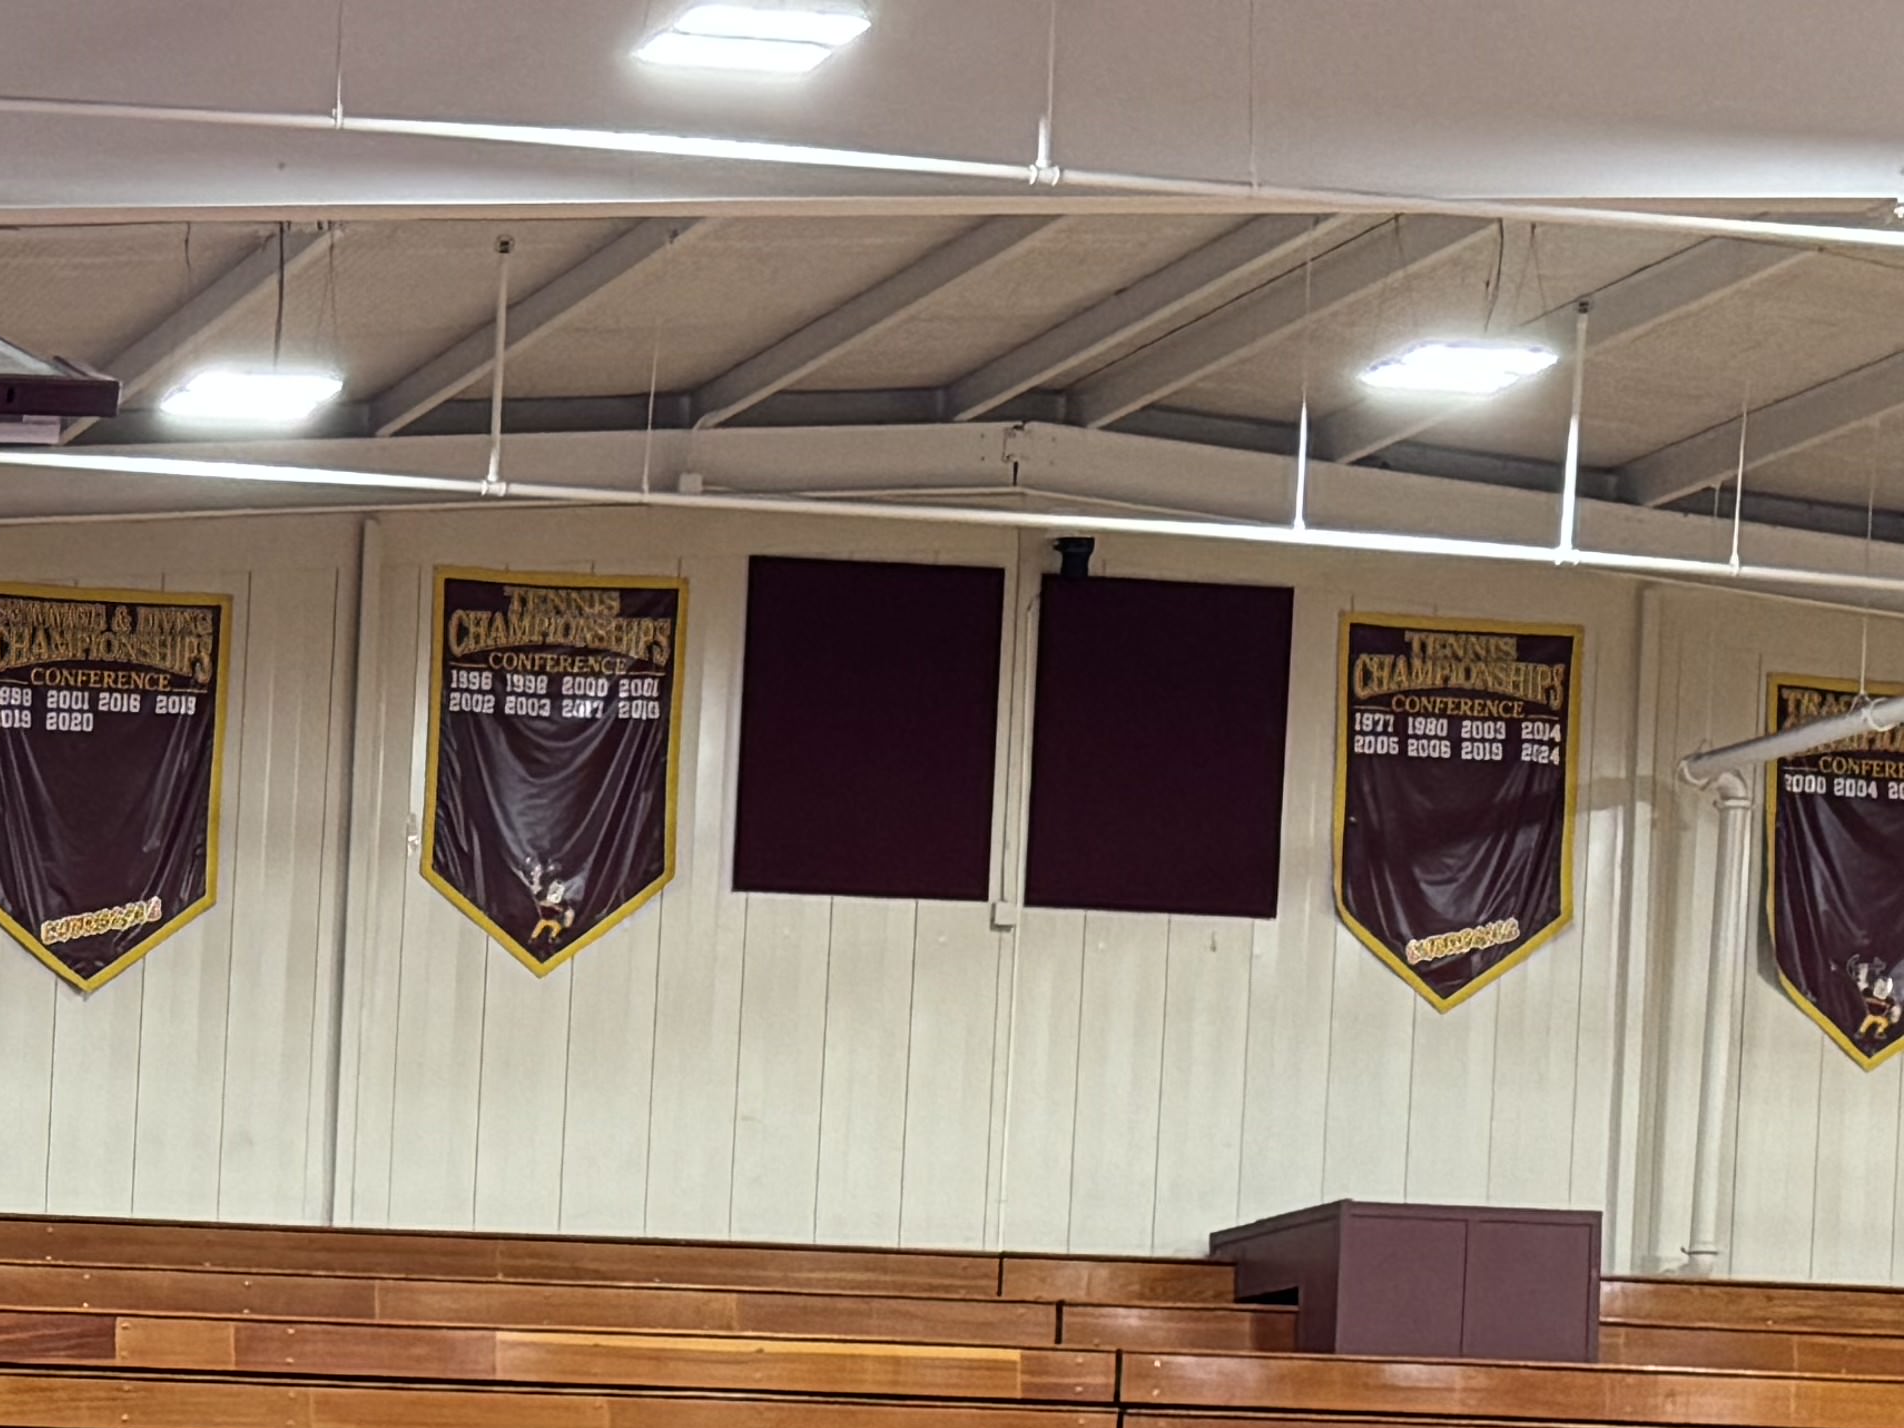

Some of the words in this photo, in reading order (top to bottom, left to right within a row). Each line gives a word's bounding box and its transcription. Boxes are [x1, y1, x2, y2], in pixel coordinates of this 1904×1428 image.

[449, 609, 672, 667] CHAMPIONSHIPS
[489, 652, 628, 676] CONFERENCE
[31, 667, 171, 692] CONFERENCE
[1353, 653, 1566, 711] CHAMPIONSHIPS
[47, 690, 90, 711] 2001
[1391, 694, 1525, 719] CONFERENCE
[46, 712, 93, 733] 2020
[1354, 712, 1395, 734] 1977
